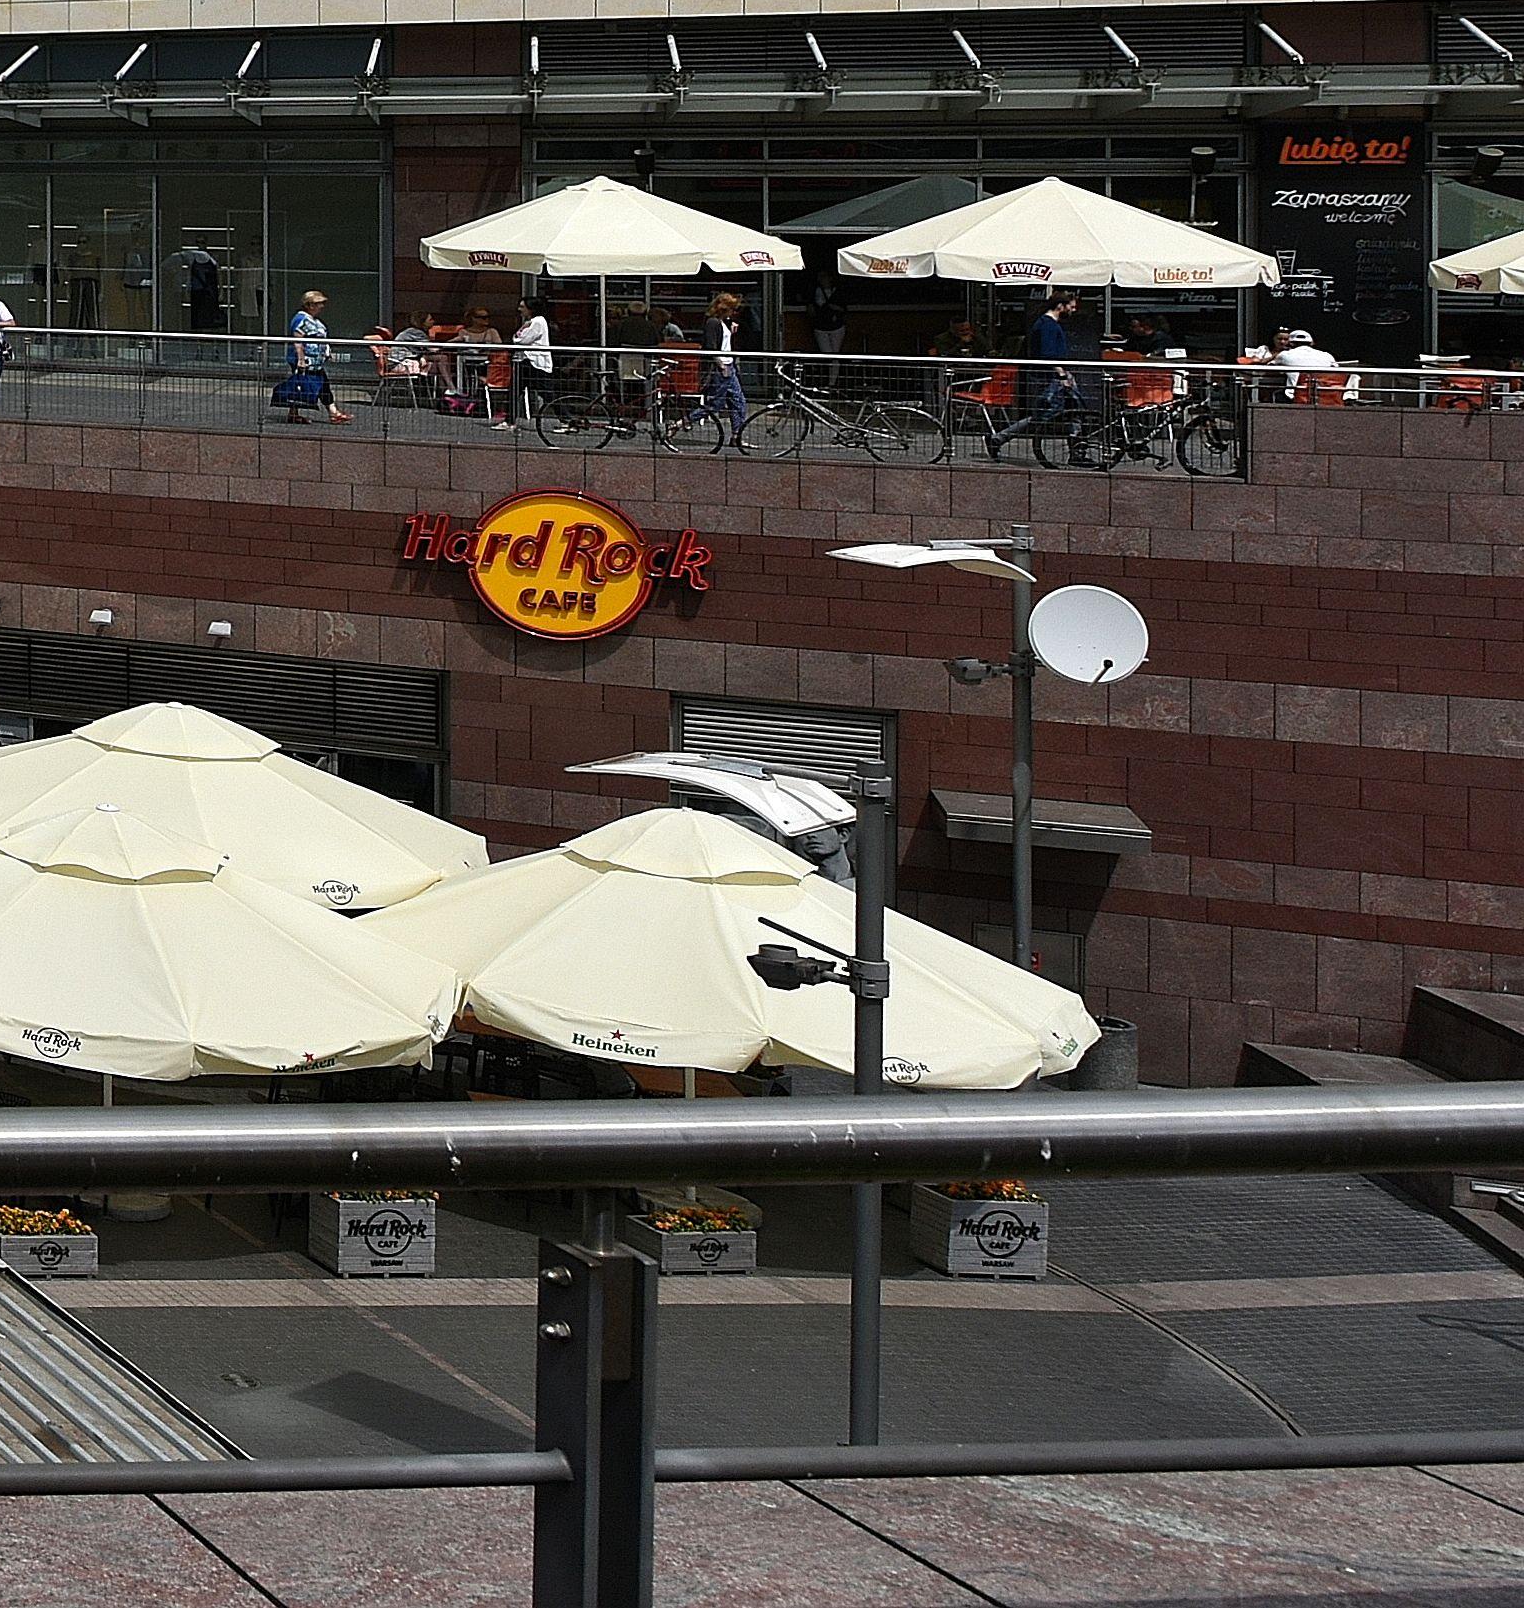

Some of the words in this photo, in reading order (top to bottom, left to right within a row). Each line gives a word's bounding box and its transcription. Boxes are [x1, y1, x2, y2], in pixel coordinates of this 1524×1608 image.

[1279, 135, 1359, 164] Lubię
[1359, 135, 1411, 164] to!
[1272, 190, 1411, 216] Zapraszamy
[998, 263, 1047, 277] ŻYWIEC
[1154, 267, 1189, 284] Lubię
[1191, 267, 1213, 283] to!
[404, 511, 554, 570] Hard
[561, 522, 713, 591] Rock
[518, 586, 597, 614] CAFE
[312, 884, 335, 894] Hard
[22, 1029, 52, 1044] Hard
[53, 1034, 81, 1051] Rock
[572, 1032, 656, 1058] Heineken
[898, 1062, 931, 1074] Rock
[347, 1219, 388, 1237] Hard
[389, 1219, 427, 1240] Rock
[959, 1219, 1000, 1236] Hard
[1001, 1220, 1040, 1241] Rock
